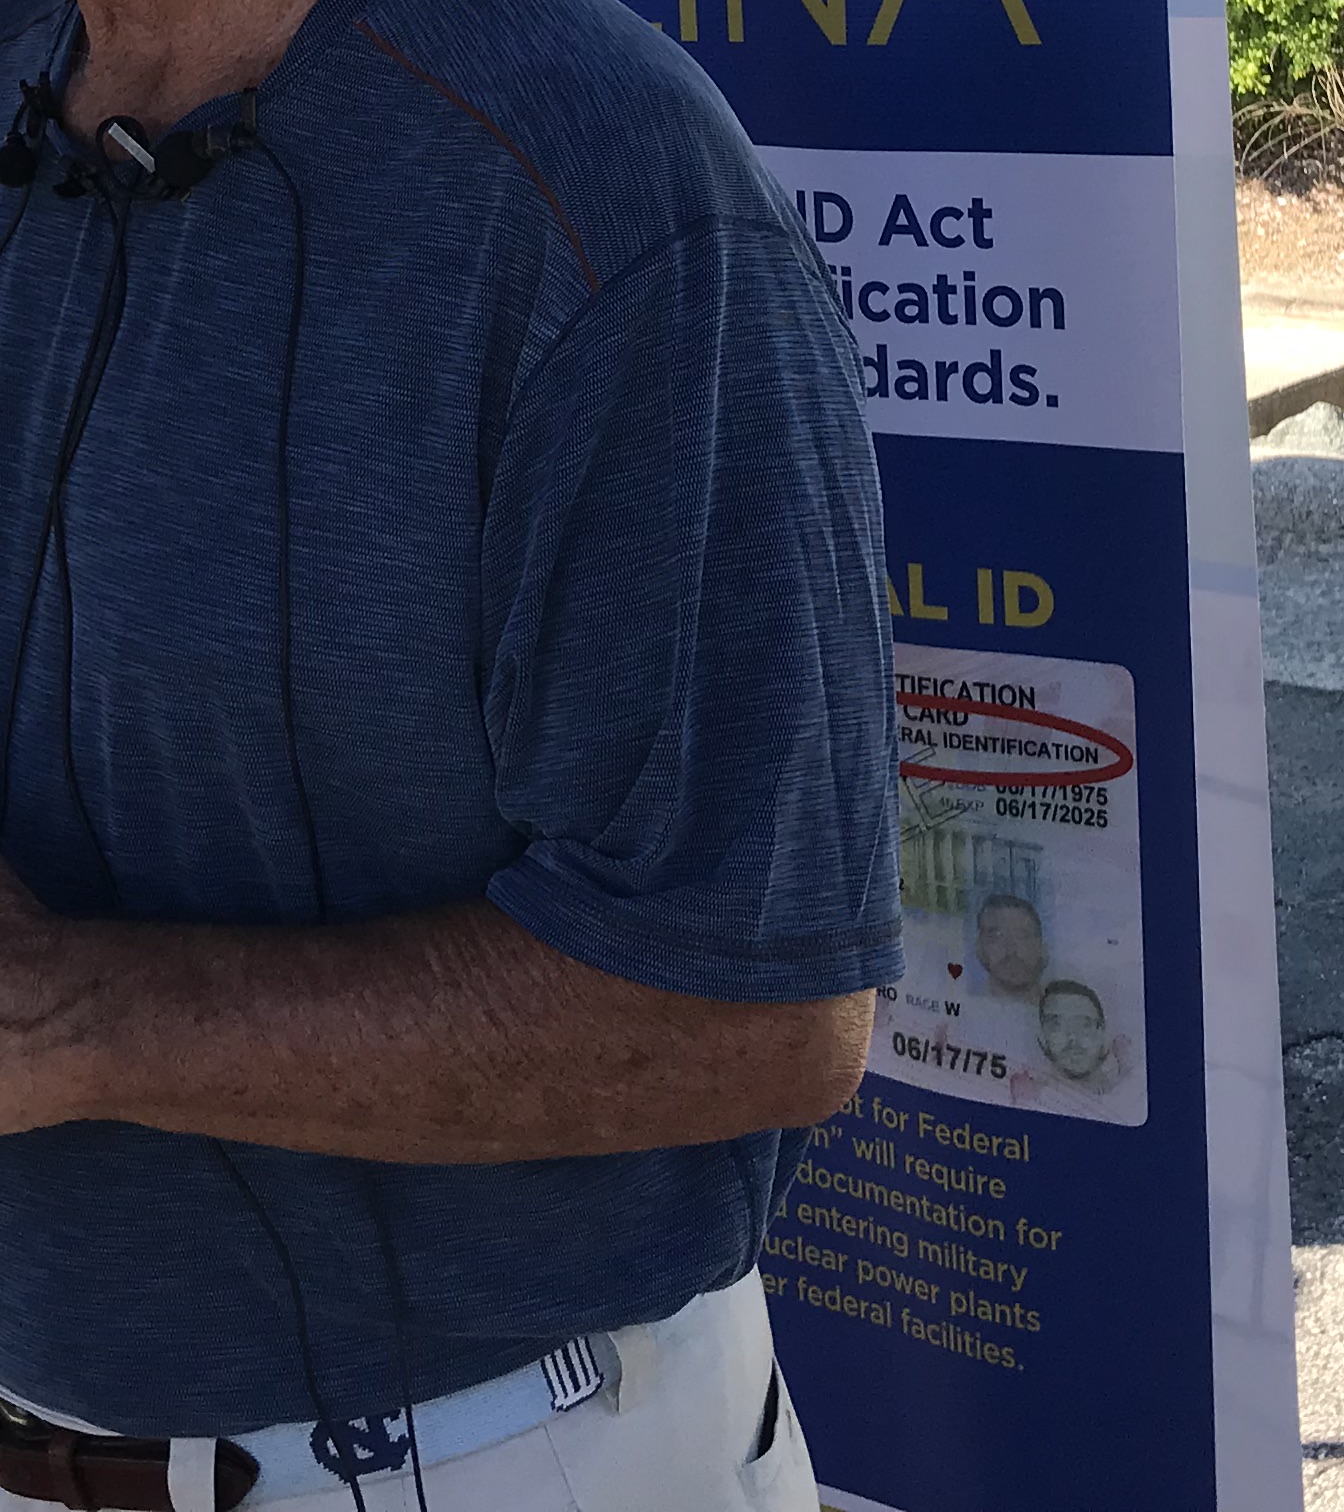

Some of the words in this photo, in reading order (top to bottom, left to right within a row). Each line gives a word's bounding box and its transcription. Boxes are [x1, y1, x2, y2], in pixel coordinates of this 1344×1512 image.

[878, 194, 995, 249] Act
[829, 264, 1066, 330] ication
[861, 344, 1060, 409] dards.
[977, 568, 1055, 628] ID
[898, 725, 938, 748] RAL
[943, 731, 1099, 764] IDENTIFICATION
[903, 704, 969, 727] CARD
[995, 797, 1108, 828] 06/17/2025
[945, 1000, 960, 1017] W
[892, 1031, 1007, 1079] 06/17/75
[872, 1097, 909, 1132] for
[918, 1112, 1030, 1163] Federal
[852, 1137, 895, 1169] will
[904, 1152, 1007, 1200] require
[797, 1159, 1006, 1242] documentation
[1016, 1217, 1062, 1251] for
[797, 1202, 909, 1258] entering
[918, 1237, 1028, 1292] military
[763, 1235, 849, 1273] uclear
[857, 1258, 941, 1305] power
[950, 1289, 1041, 1332] plants
[797, 1276, 892, 1328] federal
[901, 1308, 1025, 1372] facilities.
